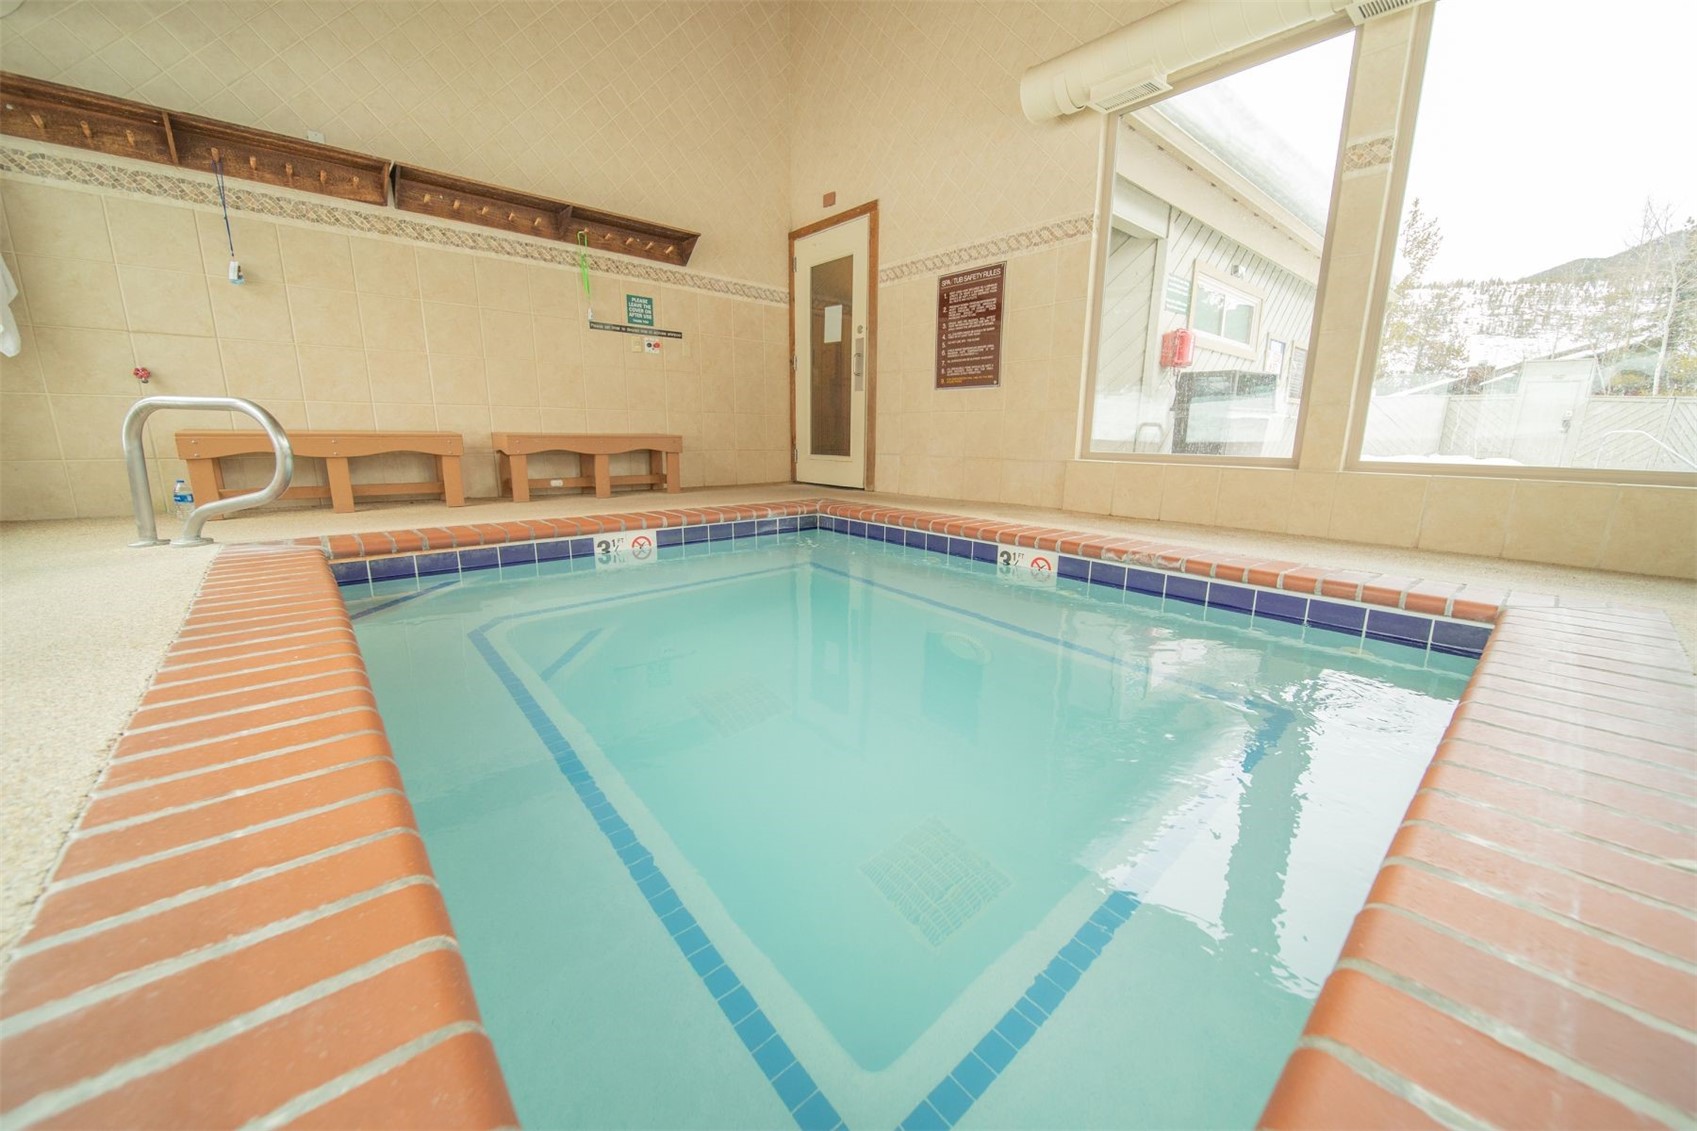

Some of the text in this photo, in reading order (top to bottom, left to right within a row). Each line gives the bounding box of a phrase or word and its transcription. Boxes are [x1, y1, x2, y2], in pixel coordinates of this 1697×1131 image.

[941, 279, 951, 287] SPA
[953, 276, 964, 285] TUB
[963, 271, 983, 282] SAFETY
[983, 267, 1001, 278] RULES
[629, 306, 644, 314] COVER
[597, 540, 611, 554] 3
